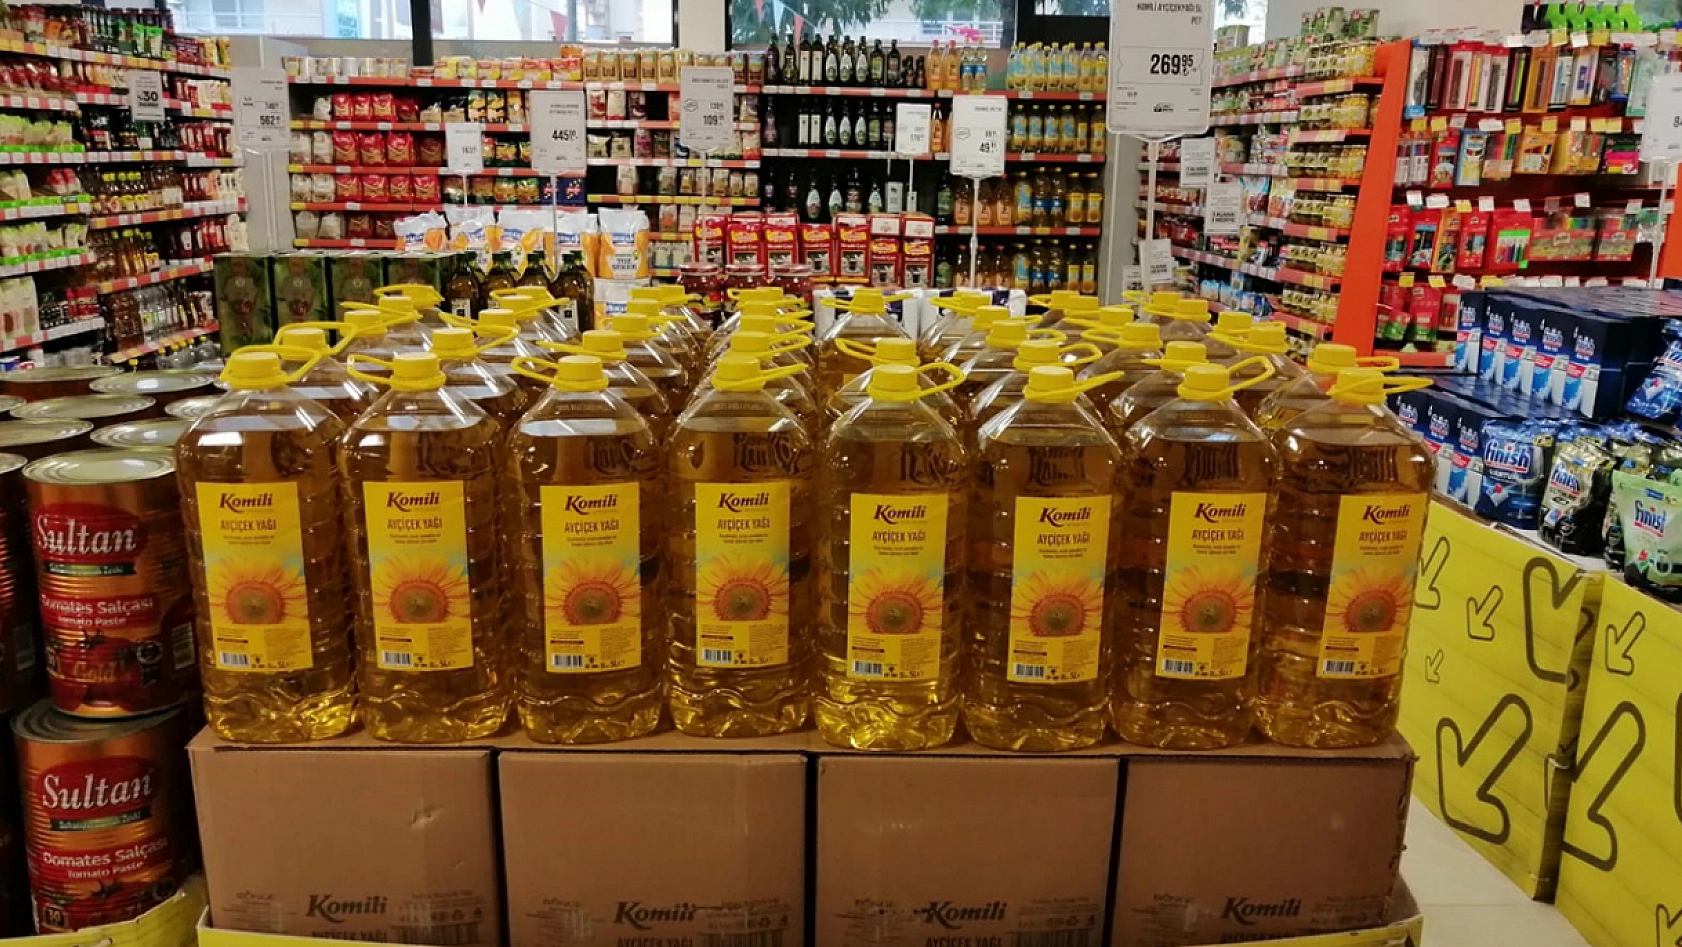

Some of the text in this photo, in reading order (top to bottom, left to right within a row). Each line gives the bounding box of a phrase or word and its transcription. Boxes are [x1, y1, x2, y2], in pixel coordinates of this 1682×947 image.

[1150, 53, 1194, 75] 269 95
[1484, 438, 1530, 472] finish
[219, 492, 275, 514] Komili
[386, 491, 440, 513] Komili
[564, 494, 618, 516] Komili
[717, 492, 770, 513] Komili
[1194, 502, 1247, 524] Komili
[873, 504, 927, 525] Komili
[1038, 507, 1092, 528] Komili
[1362, 504, 1411, 525] Komili
[38, 514, 137, 555] Sultan
[42, 773, 153, 811] Sultan
[42, 850, 111, 868] Domates
[67, 861, 147, 879] Tomato Paste
[304, 894, 389, 923] Komili
[613, 901, 697, 930] Komili
[924, 900, 1008, 930] Komili
[1218, 896, 1302, 926] Komili
